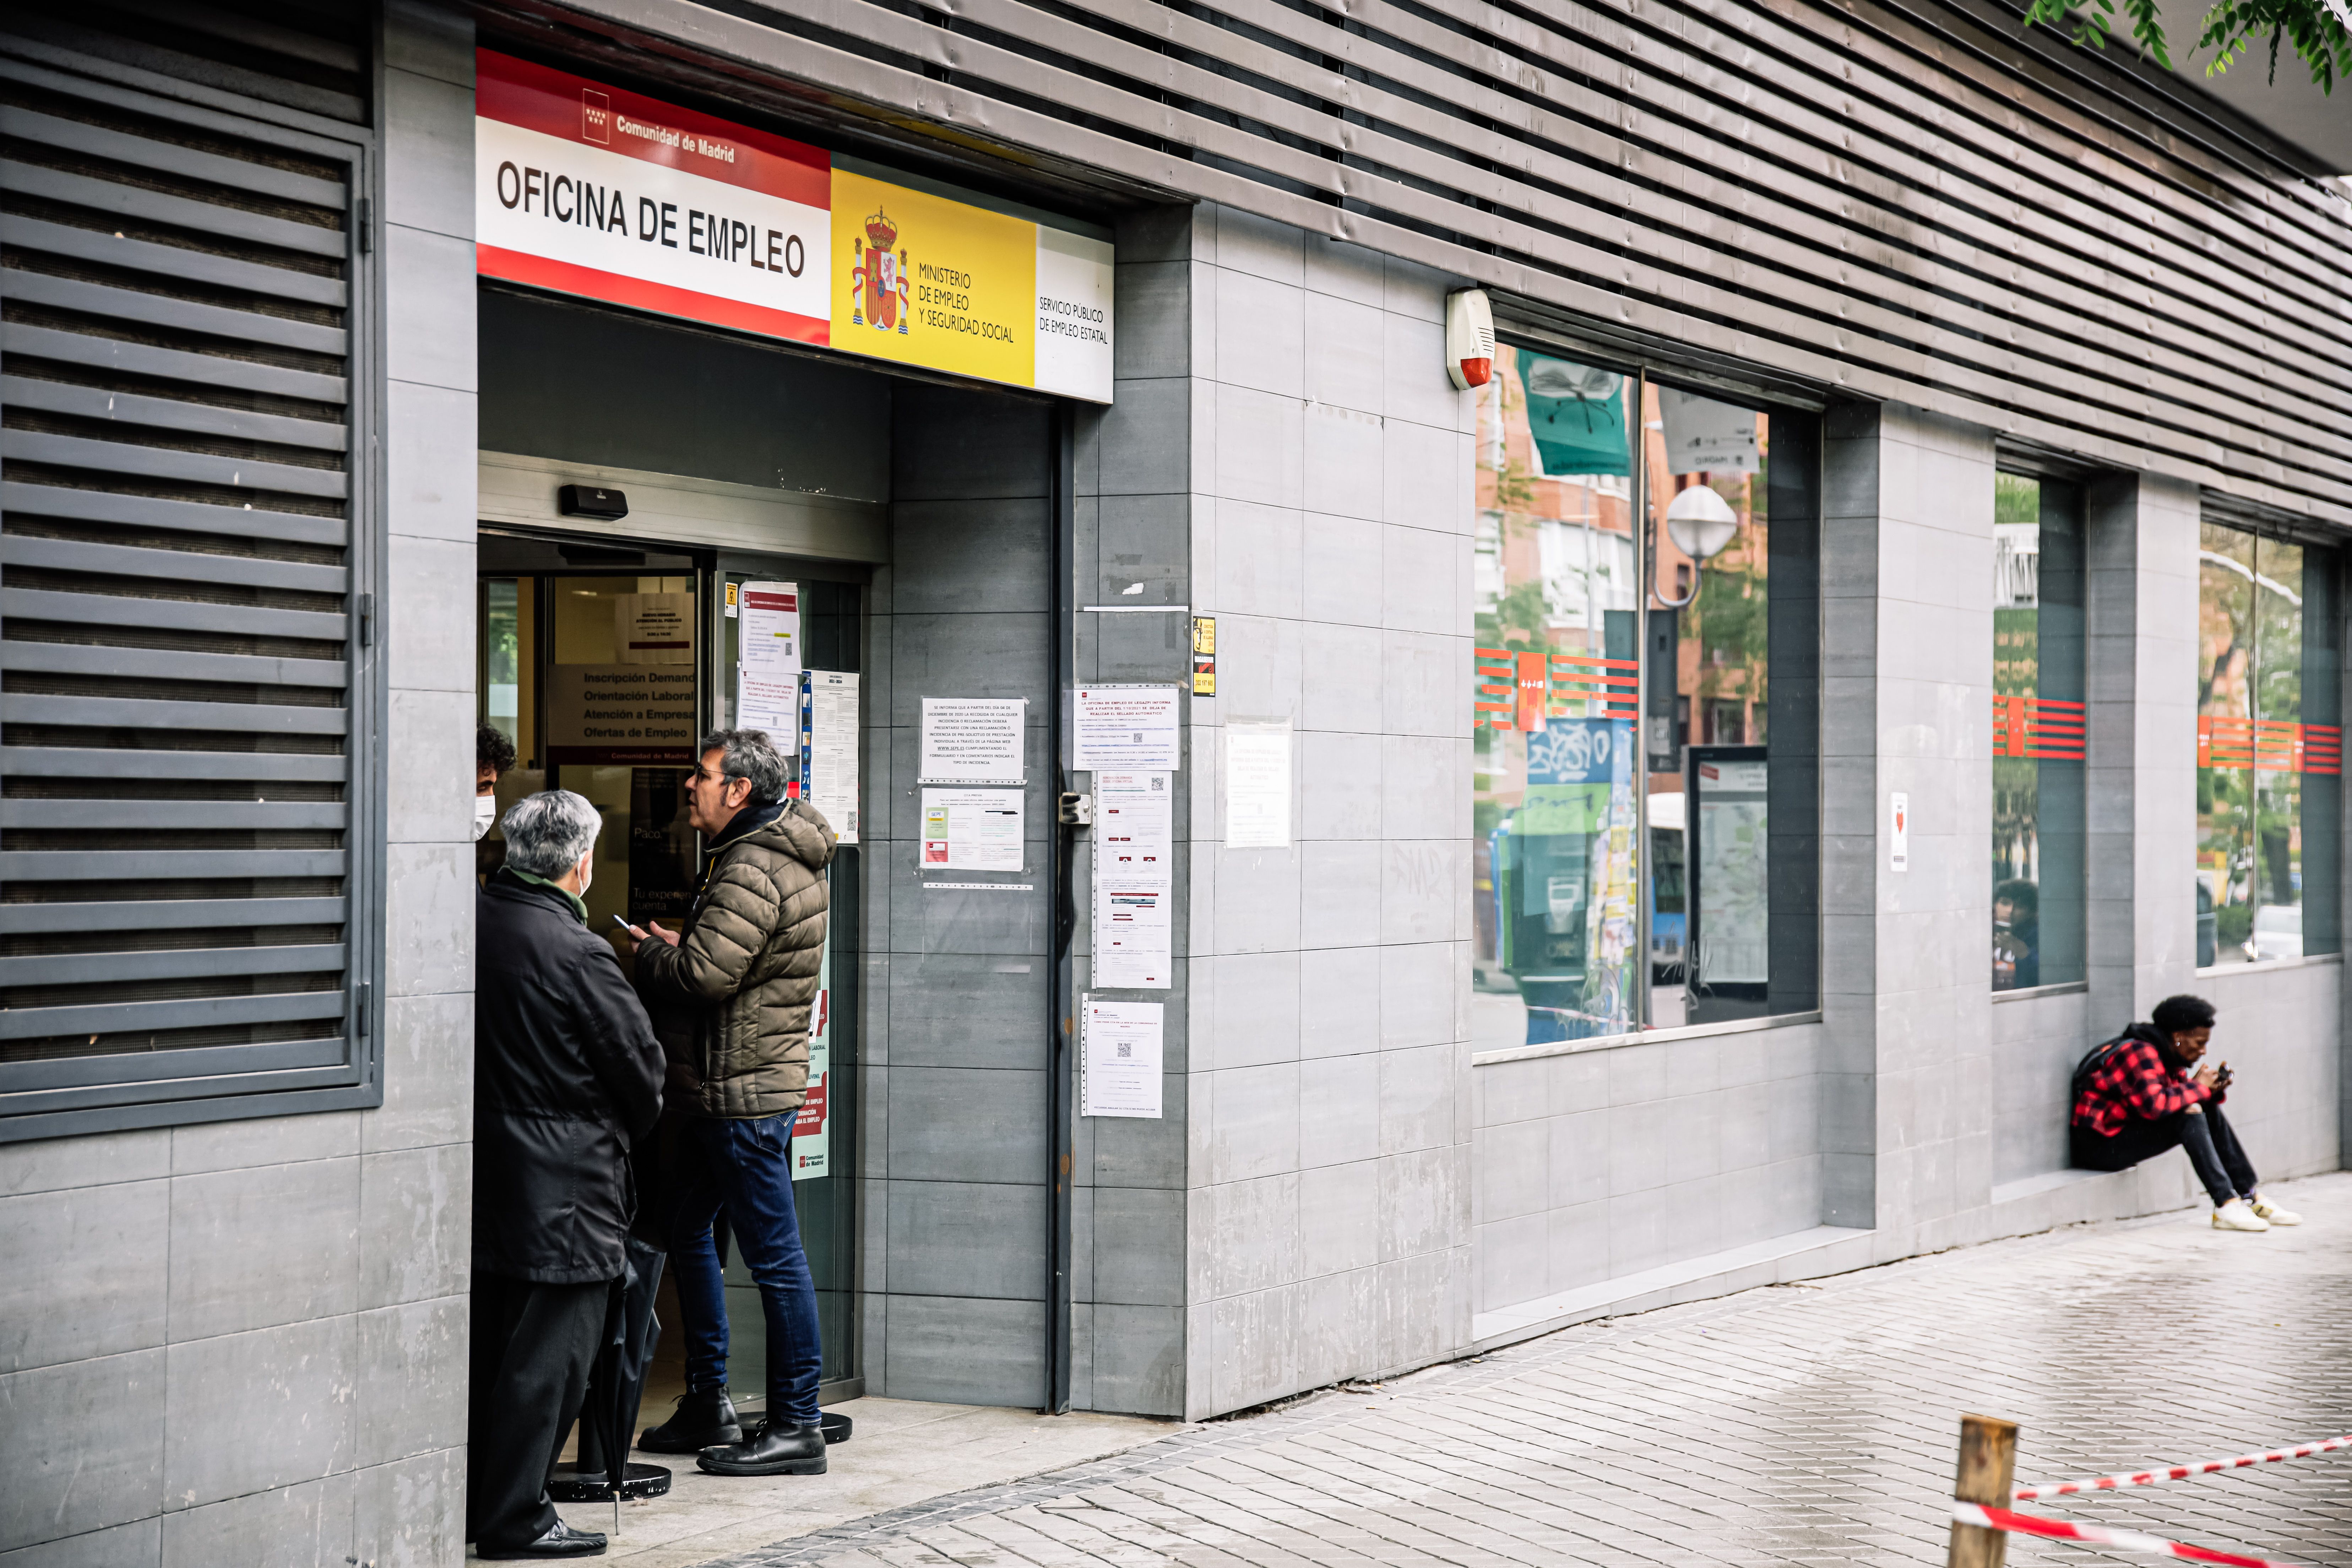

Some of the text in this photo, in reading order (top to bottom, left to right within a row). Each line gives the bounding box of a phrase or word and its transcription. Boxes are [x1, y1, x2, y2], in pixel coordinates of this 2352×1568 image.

[617, 115, 734, 163] Comunidad de Madrid
[497, 161, 804, 278] OFICINA DE EMPLEO
[919, 263, 971, 289] MINISTERIO
[919, 285, 969, 311] DE EMPLEO
[1040, 297, 1103, 323] SERVICIO PÚBLICO
[919, 308, 1014, 343] Y SEGURIDAD SOCIAL
[1040, 318, 1108, 344] DE EMPLEO ESTATAL
[584, 673, 695, 684] Inscripción Demand
[584, 690, 694, 701] Orientación Laboral
[584, 709, 633, 720] Atención
[646, 710, 695, 721] Empresa
[584, 727, 687, 739] Ofertas de Empleo
[635, 828, 662, 839] Paco.
[634, 888, 691, 900] Tu experien
[798, 1108, 816, 1116] ORMACIÓN
